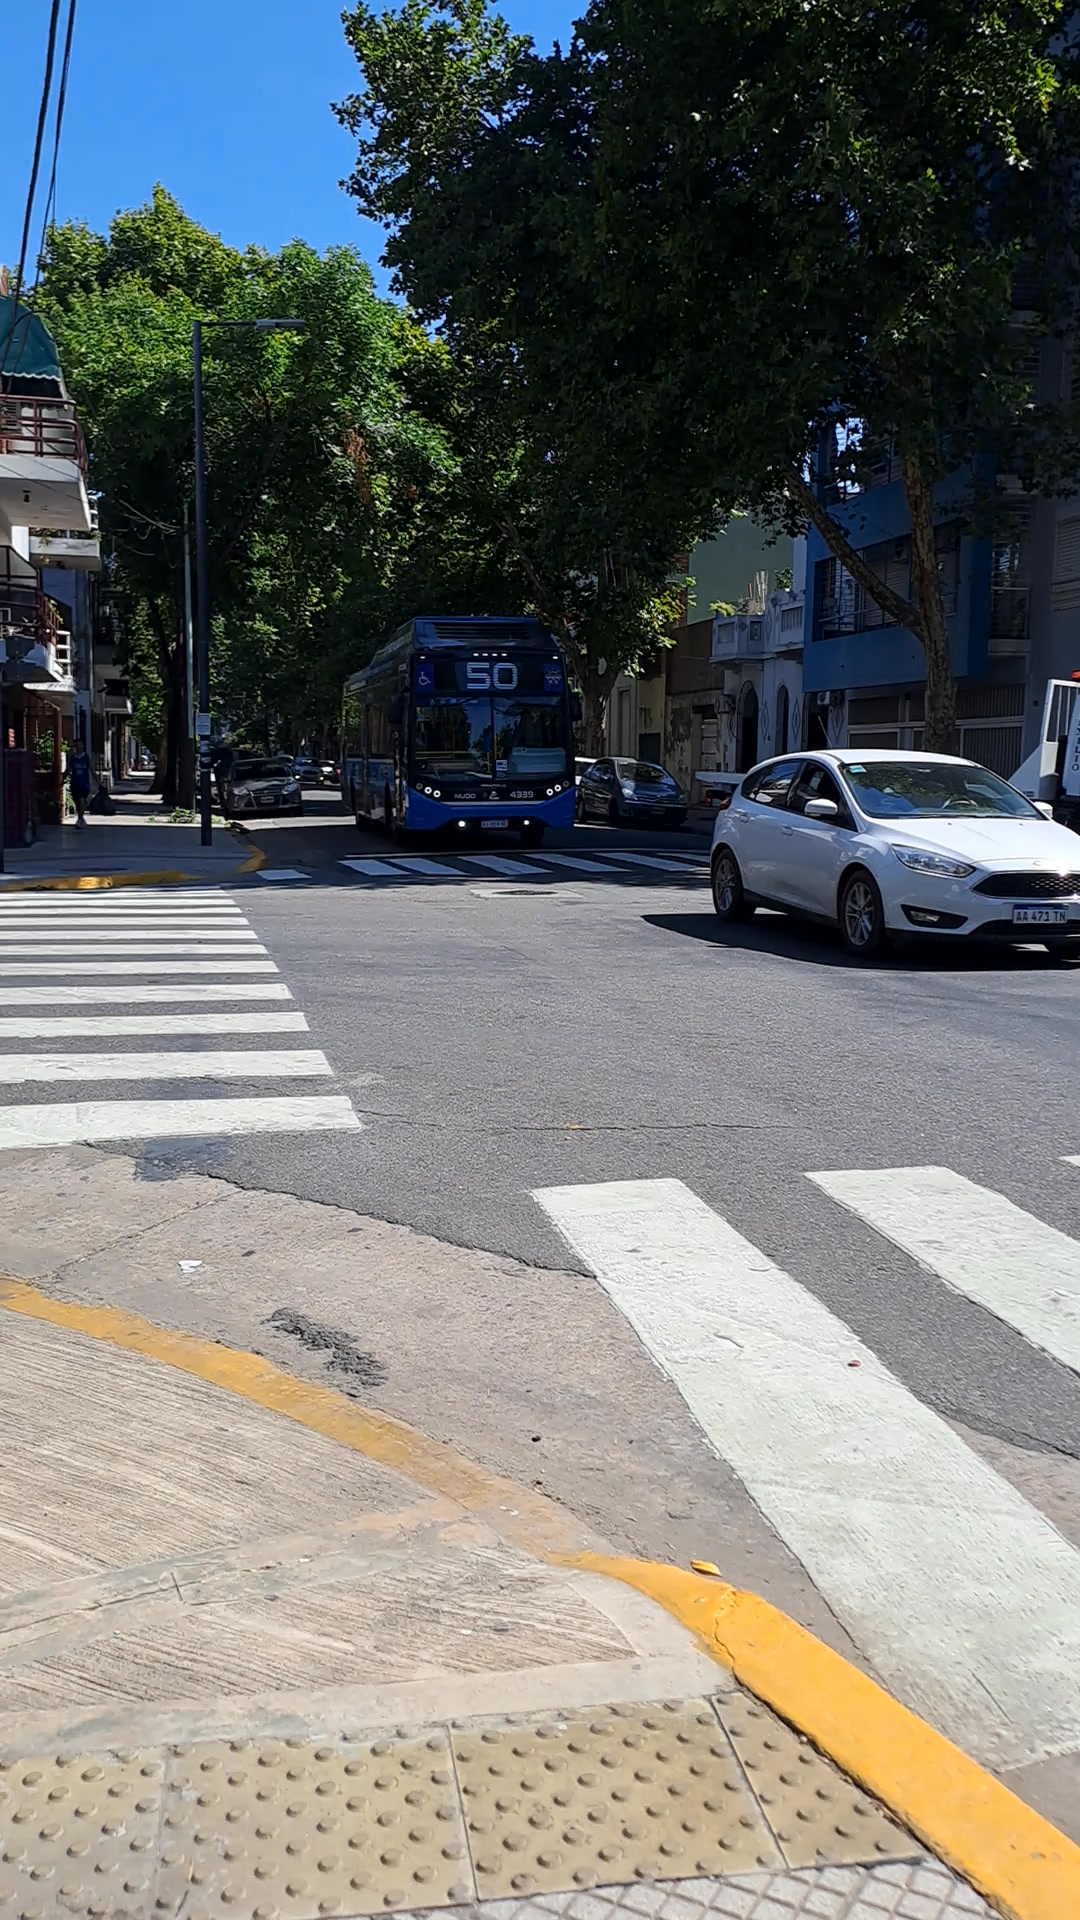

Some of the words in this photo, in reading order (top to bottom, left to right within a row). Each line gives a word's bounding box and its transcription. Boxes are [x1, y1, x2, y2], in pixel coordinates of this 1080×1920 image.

[466, 661, 519, 690] 50
[454, 792, 476, 800] NUDO
[510, 790, 534, 799] 4339
[1016, 911, 1029, 922] AA
[1053, 911, 1066, 922] TN
